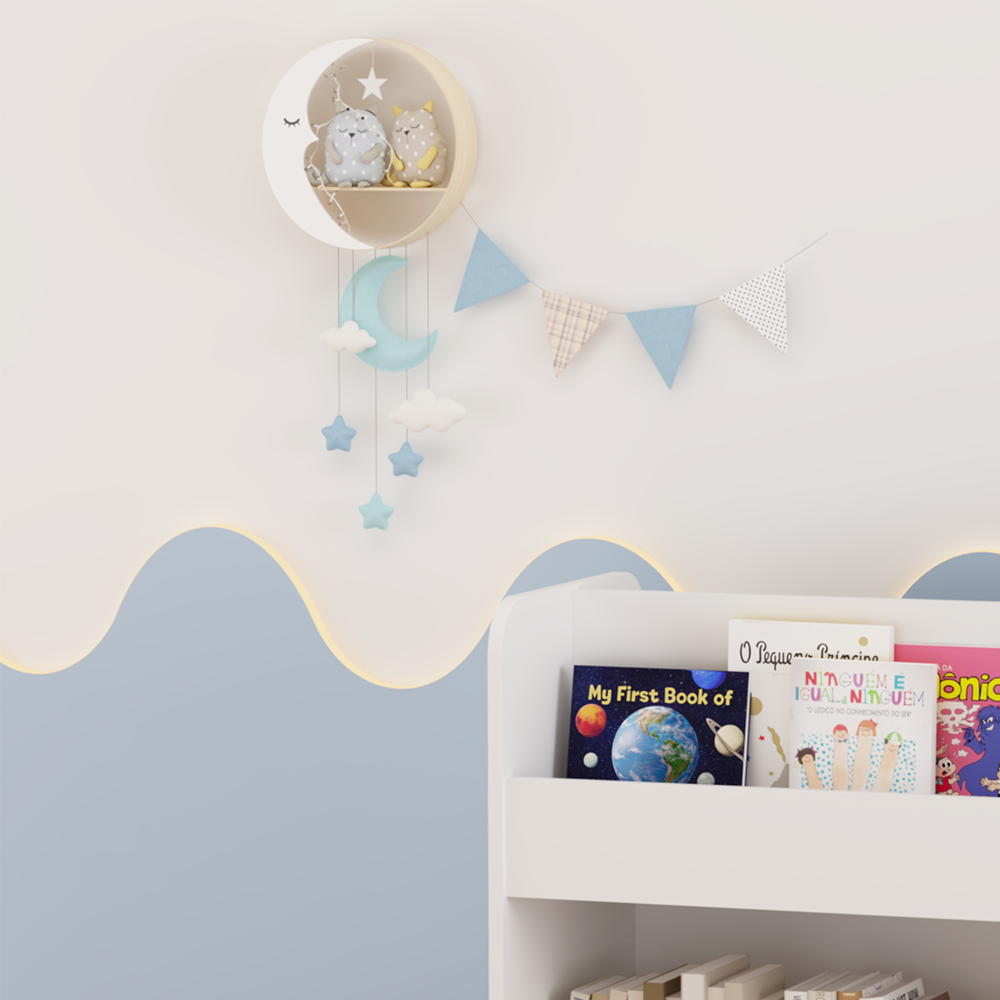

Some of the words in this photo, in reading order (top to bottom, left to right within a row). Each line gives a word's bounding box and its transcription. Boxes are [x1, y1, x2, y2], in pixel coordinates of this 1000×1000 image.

[739, 640, 752, 664] O
[894, 672, 905, 690] É
[588, 684, 613, 705] My
[617, 686, 660, 703] First
[664, 687, 708, 705] Book
[713, 690, 734, 706] of
[795, 686, 840, 703] IGUAL
[814, 706, 835, 715] LÚDICO
[836, 707, 846, 715] NO
[846, 708, 890, 717] CONHECIMENTO
[891, 709, 901, 718] DO
